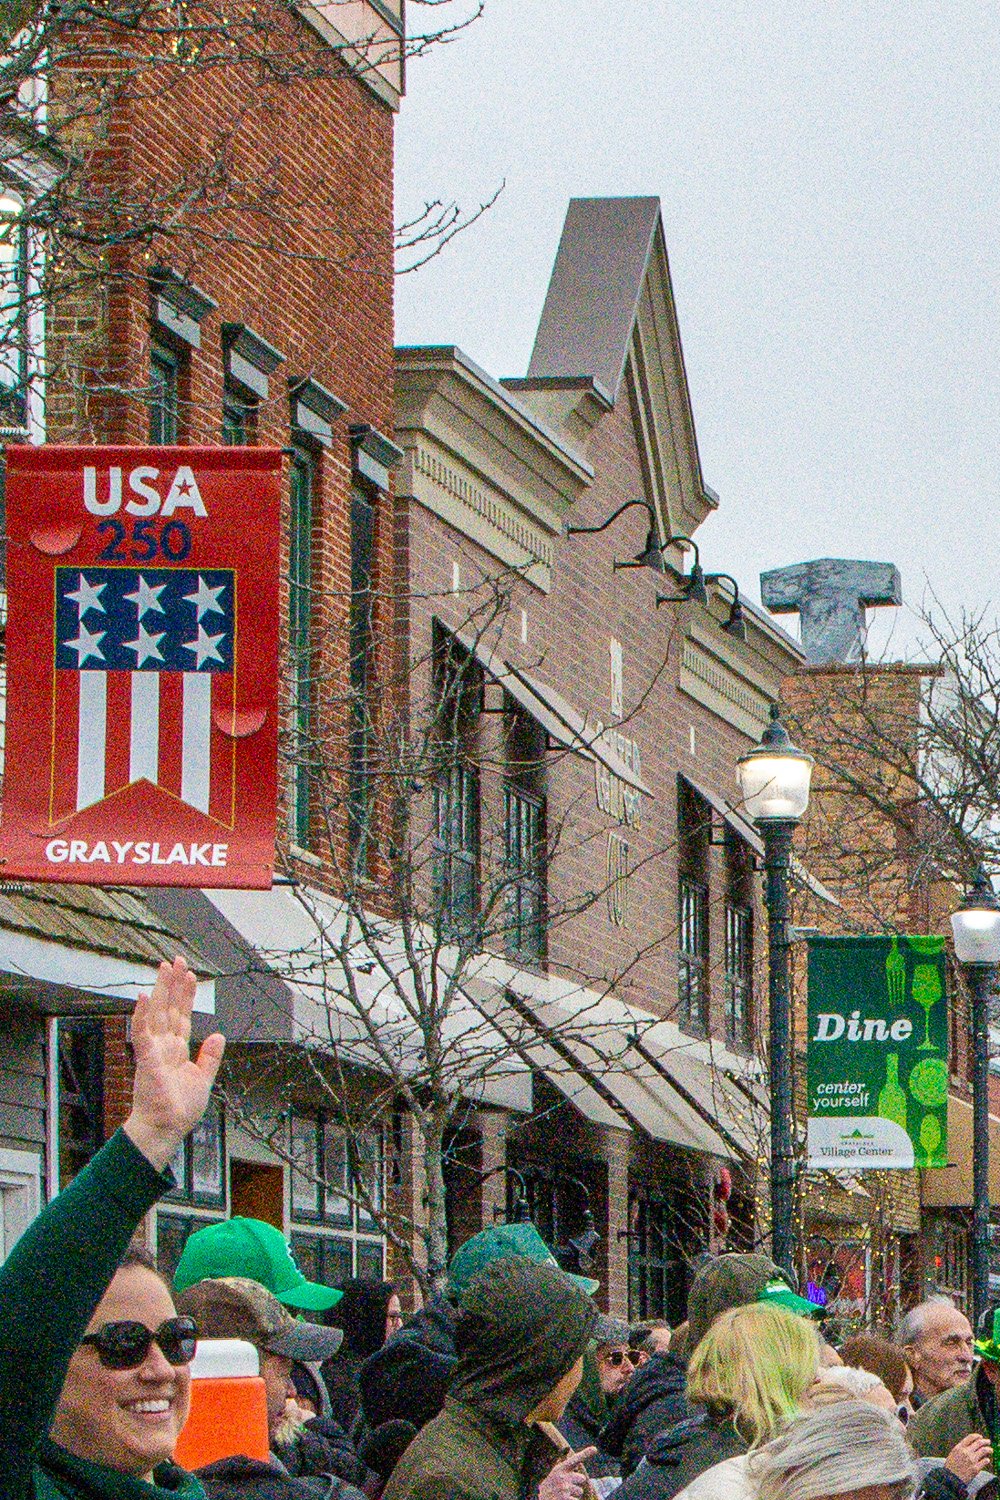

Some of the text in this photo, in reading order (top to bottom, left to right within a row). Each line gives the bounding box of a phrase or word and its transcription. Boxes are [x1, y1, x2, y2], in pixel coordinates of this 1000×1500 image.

[83, 465, 208, 518] USA
[95, 519, 193, 562] 250
[45, 839, 229, 867] GRAYSLAKE
[813, 1010, 913, 1042] Dine
[812, 1092, 870, 1111] yourself
[816, 1080, 866, 1095] center
[820, 1147, 893, 1159] Village Center
